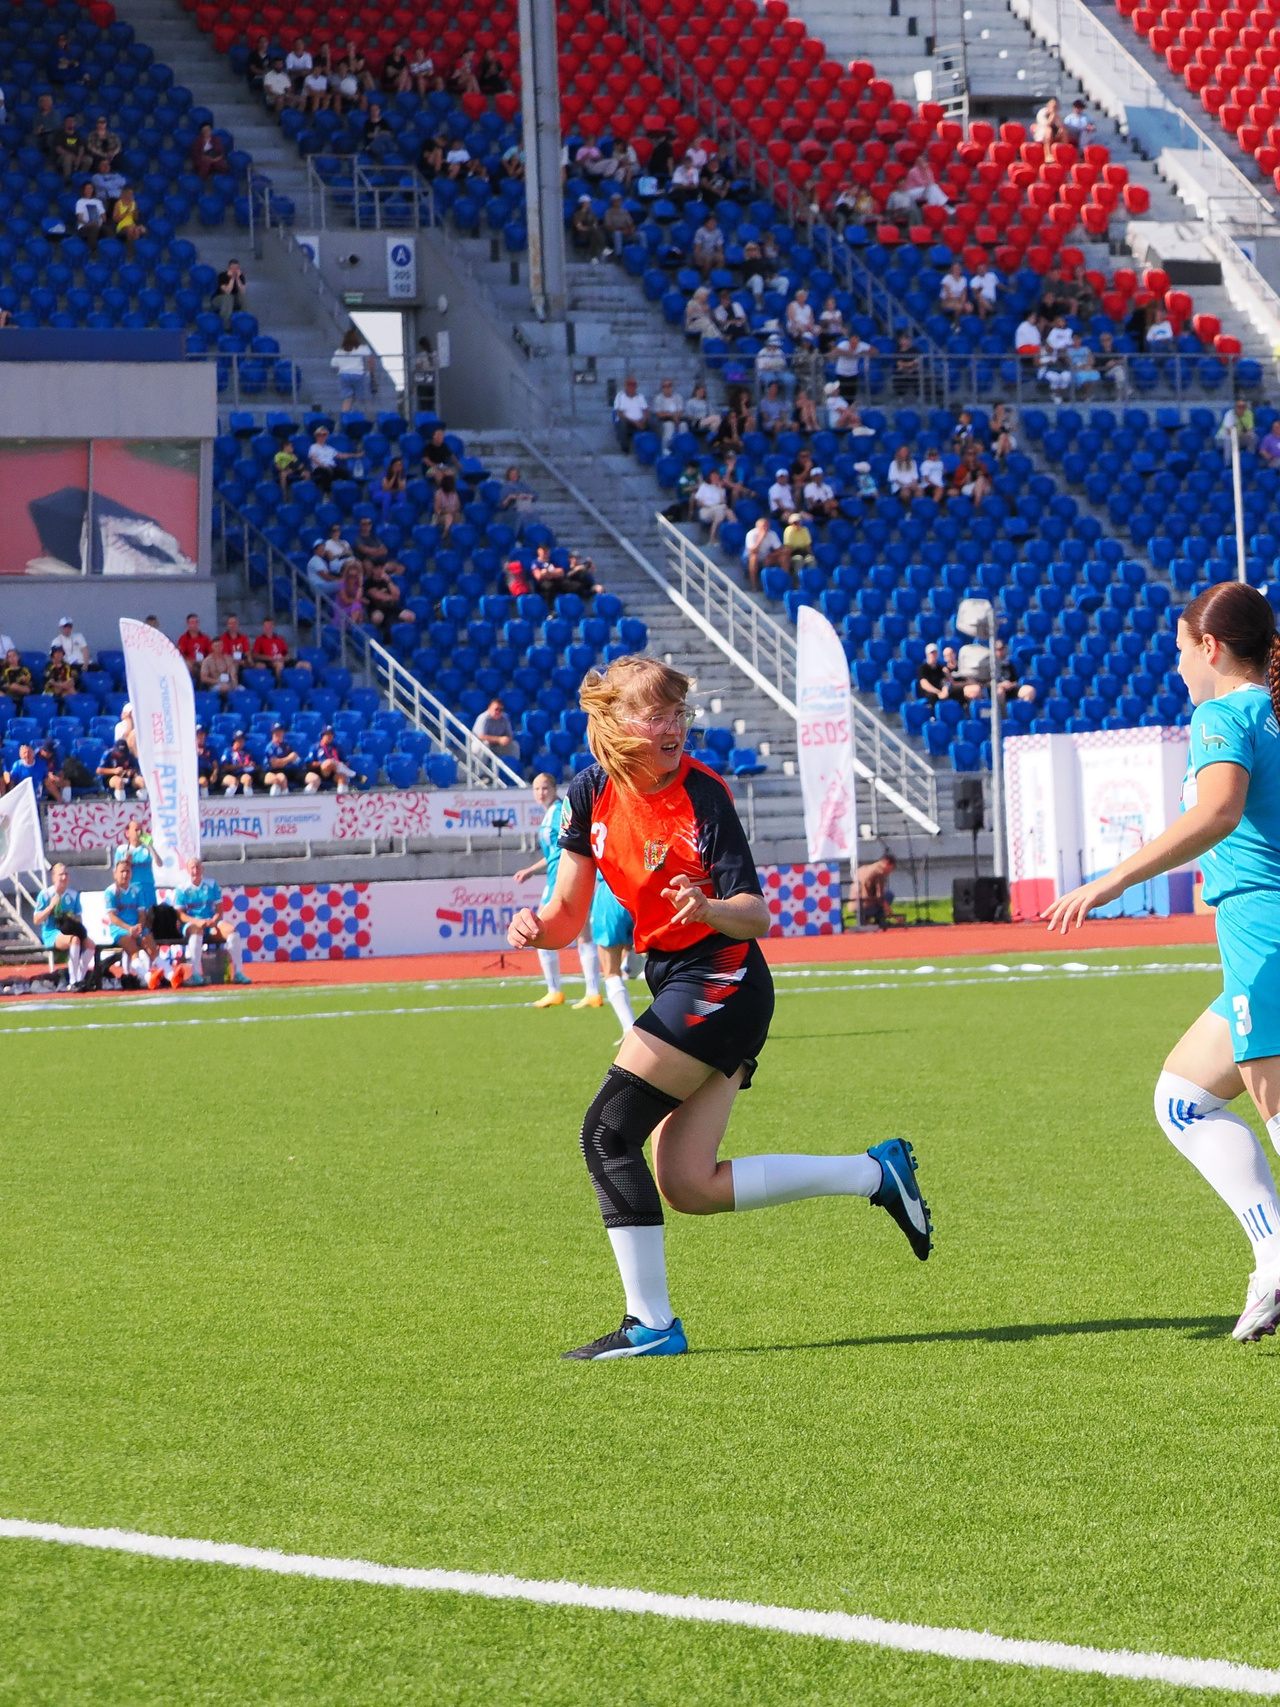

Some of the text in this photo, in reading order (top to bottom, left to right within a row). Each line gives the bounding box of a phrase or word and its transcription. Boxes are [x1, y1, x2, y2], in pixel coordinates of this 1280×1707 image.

[202, 817, 263, 838] ЛАПТА
[459, 808, 518, 828] ЛАПТА
[591, 821, 608, 860] 3
[459, 905, 540, 937] ЛАП
[1232, 994, 1253, 1037] 3
